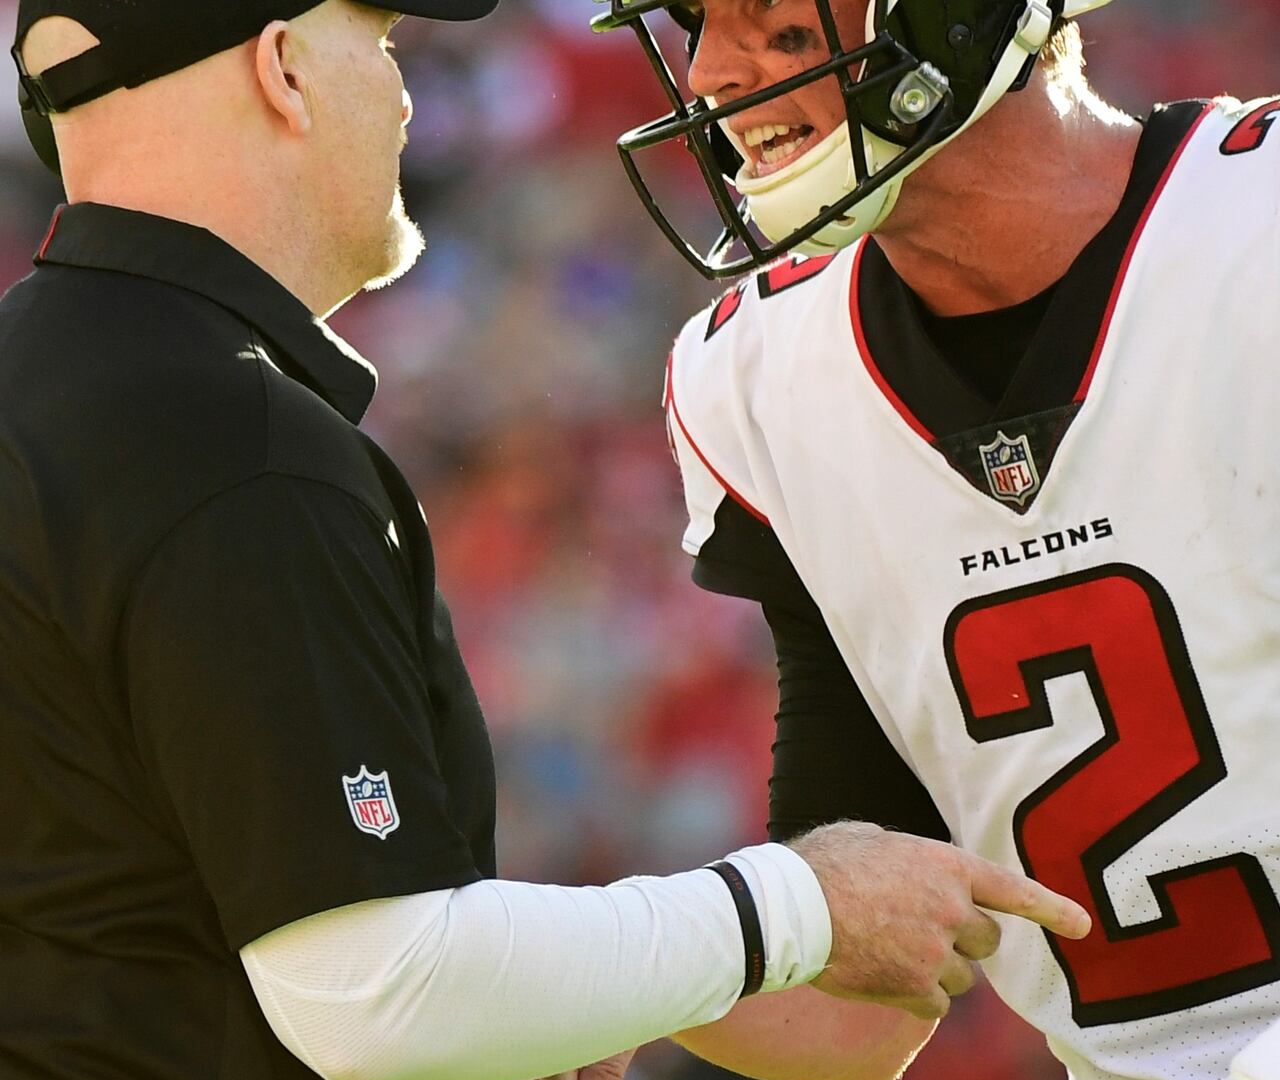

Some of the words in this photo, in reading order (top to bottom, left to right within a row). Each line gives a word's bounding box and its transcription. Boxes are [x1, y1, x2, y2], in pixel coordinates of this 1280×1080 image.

[993, 464, 1030, 492] NFL
[959, 517, 1113, 576] FALCONS
[355, 800, 391, 826] NFL
